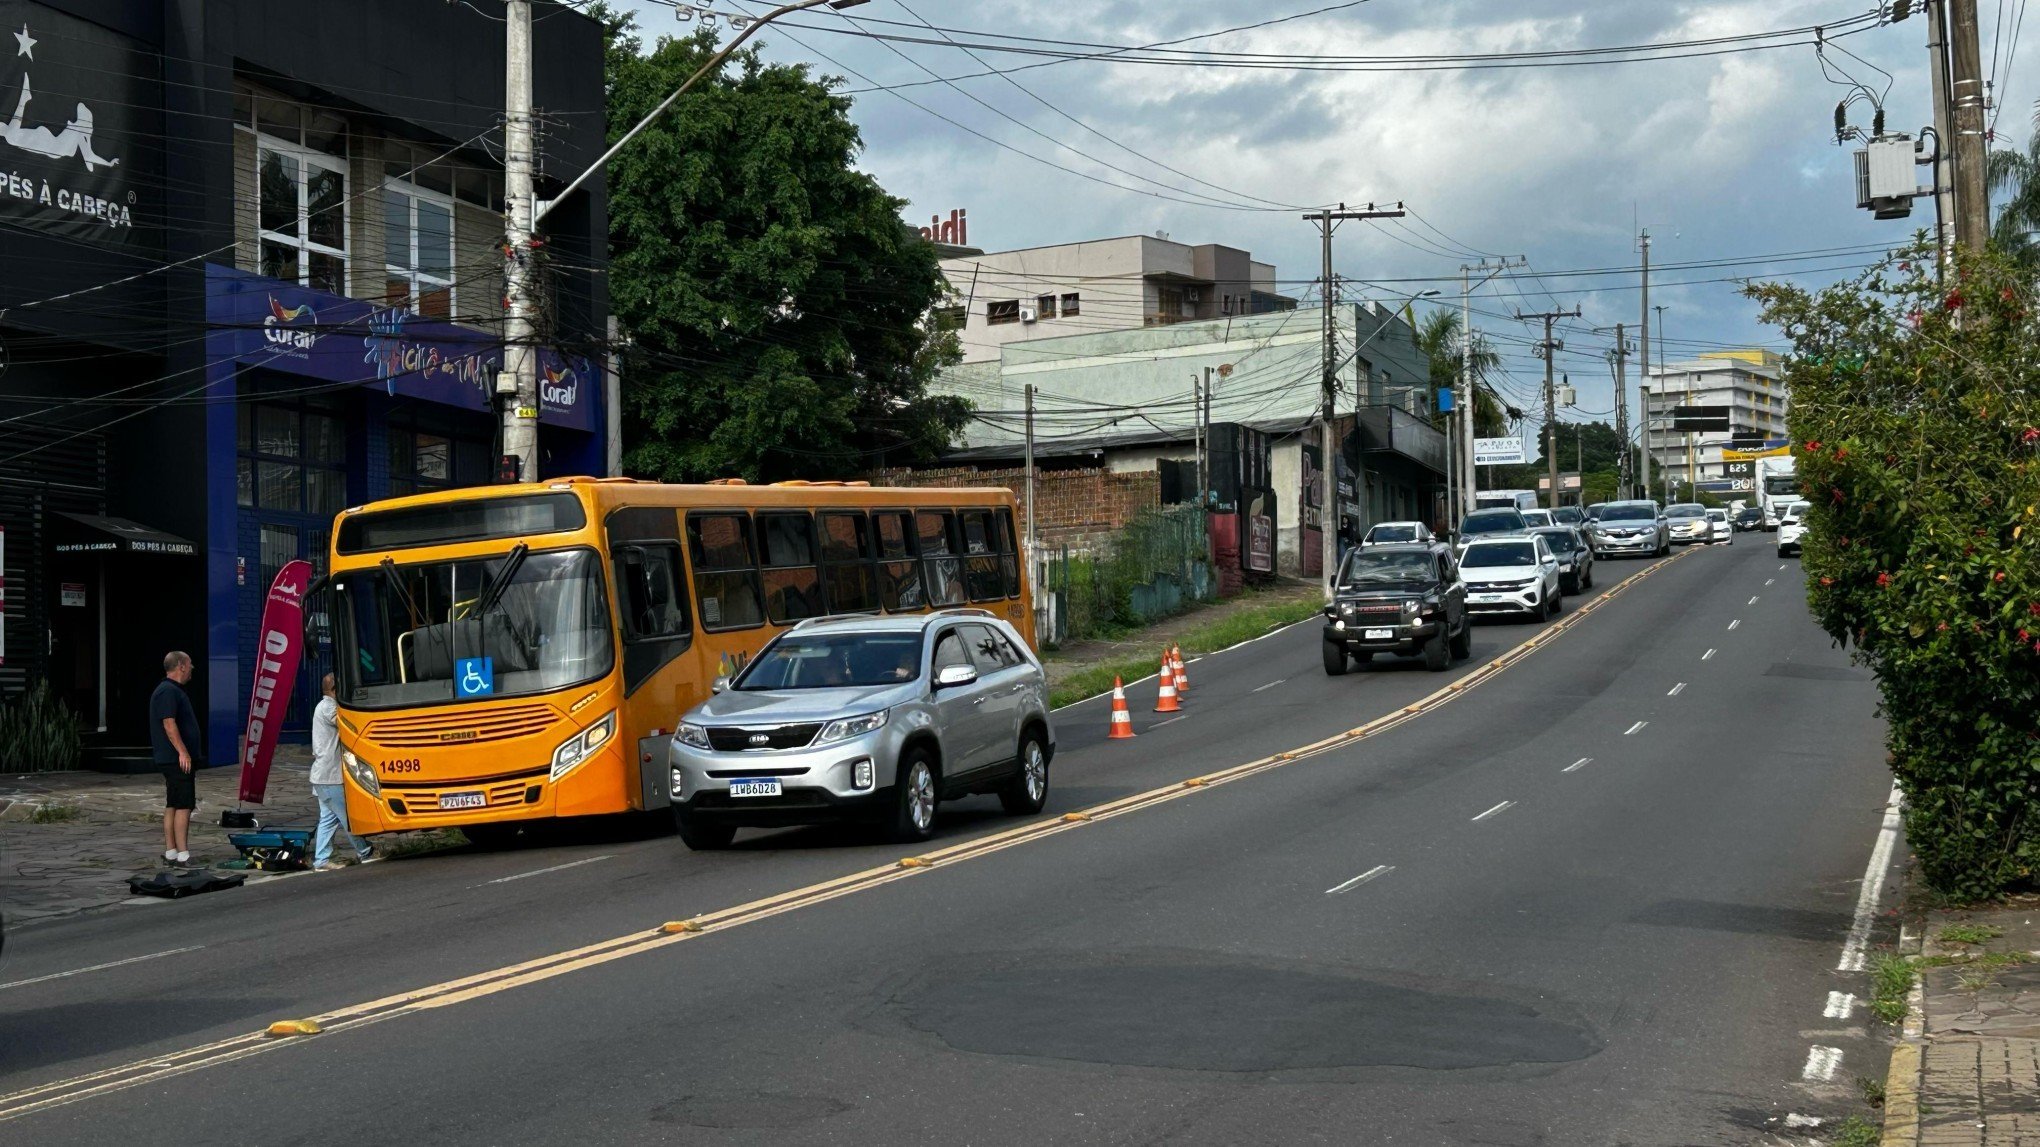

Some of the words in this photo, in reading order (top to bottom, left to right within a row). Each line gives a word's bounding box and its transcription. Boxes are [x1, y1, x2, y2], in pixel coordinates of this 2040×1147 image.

[0, 171, 34, 200] PÉS
[40, 179, 52, 206] À
[57, 188, 132, 228] CABEÇA
[540, 379, 574, 405] Coral
[131, 541, 146, 551] DOS
[167, 543, 194, 554] CABEÇA
[246, 629, 289, 768] ABERTO
[750, 734, 769, 744] KIA
[379, 758, 421, 774] 14998
